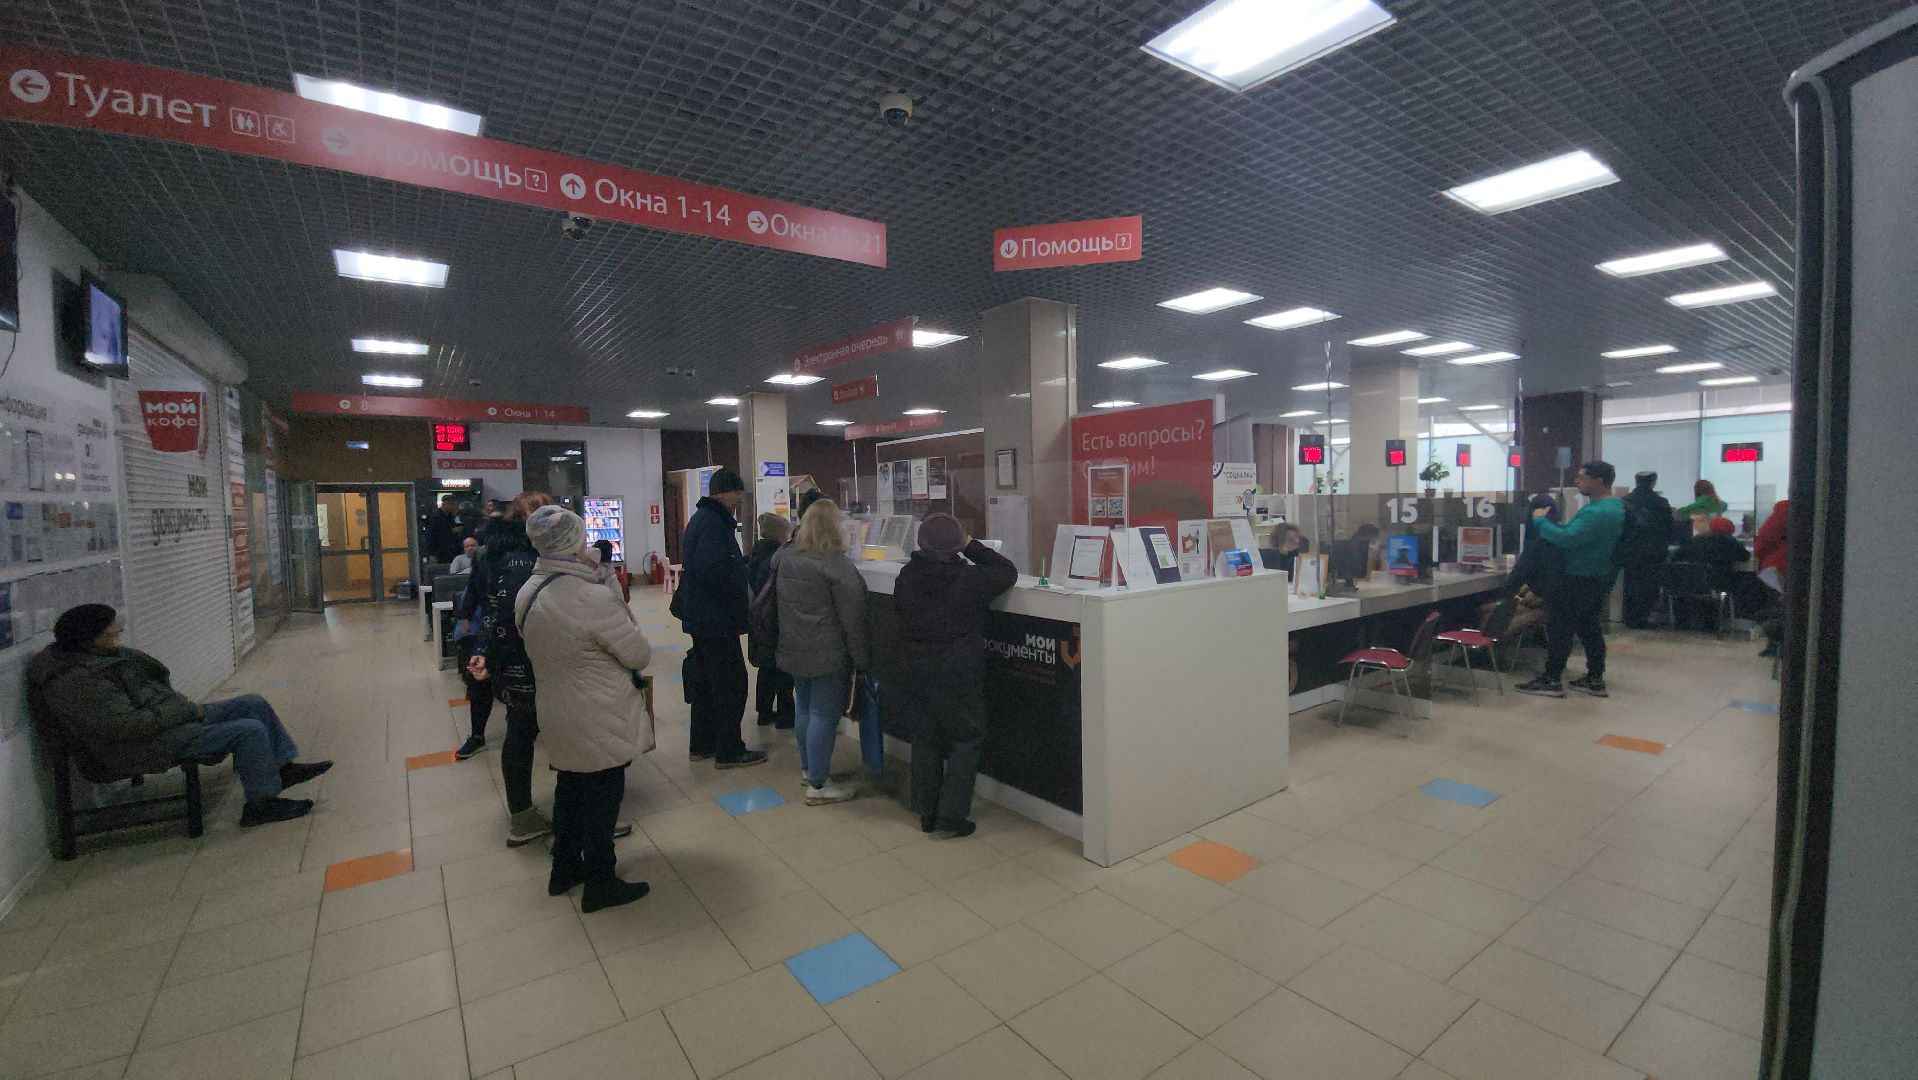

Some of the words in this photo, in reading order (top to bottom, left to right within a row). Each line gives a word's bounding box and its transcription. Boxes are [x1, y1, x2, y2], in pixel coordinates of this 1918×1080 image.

[56, 71, 217, 128] Туалет
[595, 178, 668, 215] Окна
[677, 196, 731, 226] 1-14
[770, 213, 828, 243] Окна
[1022, 236, 1113, 258] Помощь
[803, 344, 850, 368] Электронная
[851, 335, 889, 354] очередь
[504, 409, 531, 418] Окна
[1082, 433, 1114, 452] Есть
[1118, 419, 1206, 450] вопросы?
[1386, 498, 1419, 524] 15
[1463, 498, 1496, 519] 16
[1025, 633, 1056, 652] мои
